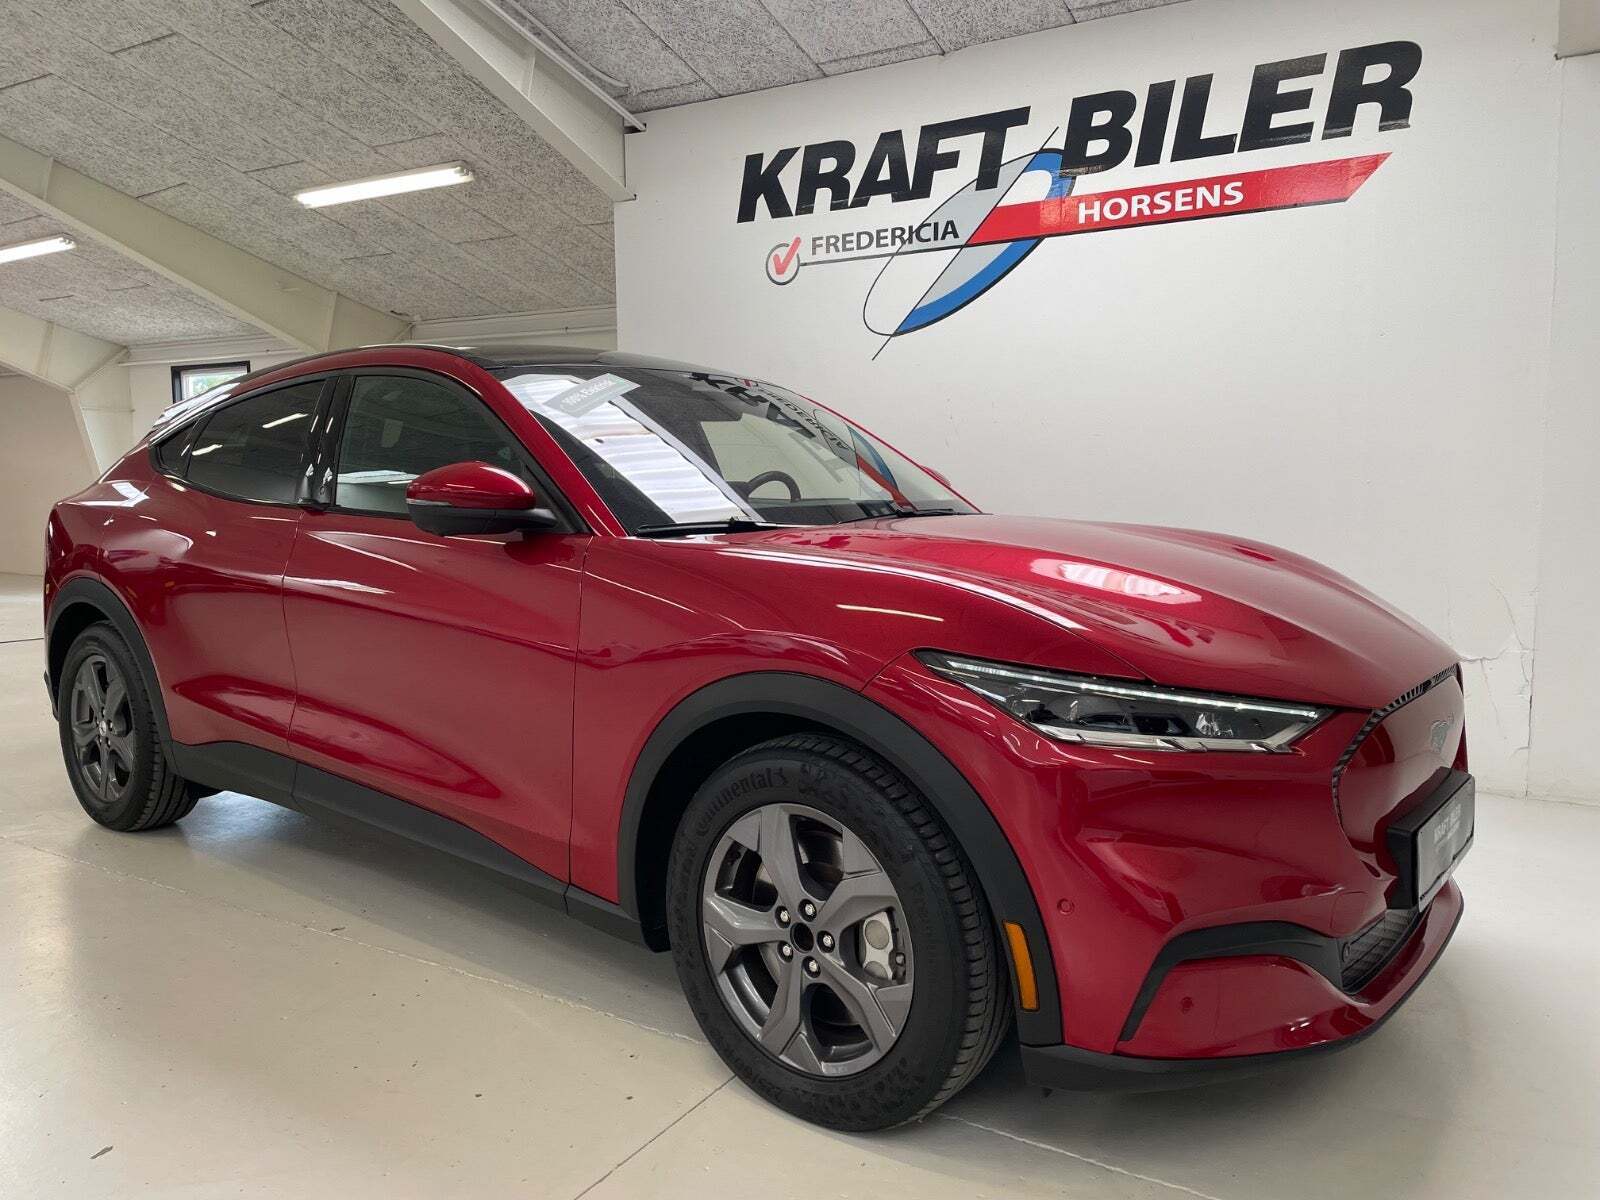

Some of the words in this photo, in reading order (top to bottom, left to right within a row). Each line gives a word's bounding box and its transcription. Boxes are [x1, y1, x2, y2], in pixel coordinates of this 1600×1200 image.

[737, 106, 1031, 223] KRAFT
[1059, 41, 1422, 178] BILER
[1078, 181, 1244, 224] HORSENS
[811, 219, 960, 256] FREDERICIA
